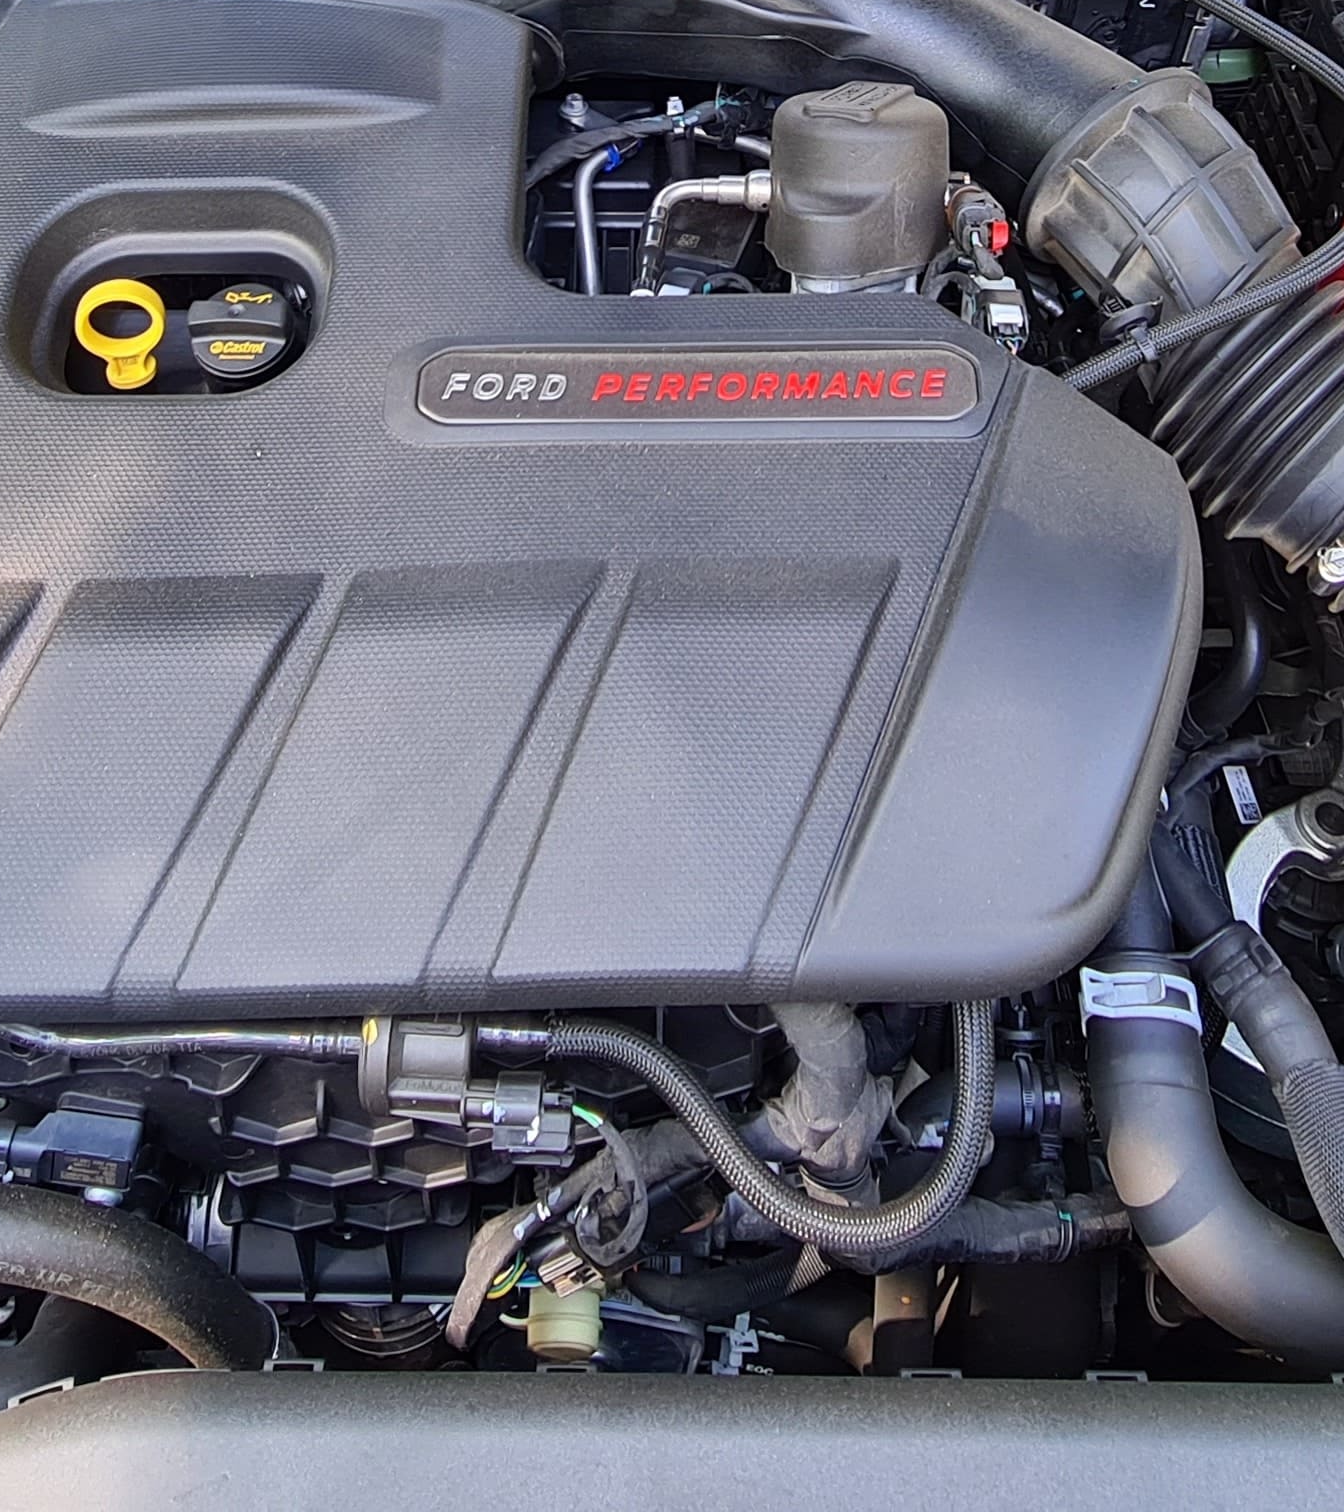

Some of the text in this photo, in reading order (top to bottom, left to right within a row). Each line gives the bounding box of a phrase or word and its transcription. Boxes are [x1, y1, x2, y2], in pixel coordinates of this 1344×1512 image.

[222, 341, 267, 354] Castrol
[441, 367, 949, 403] FORD PERFORMANCE
